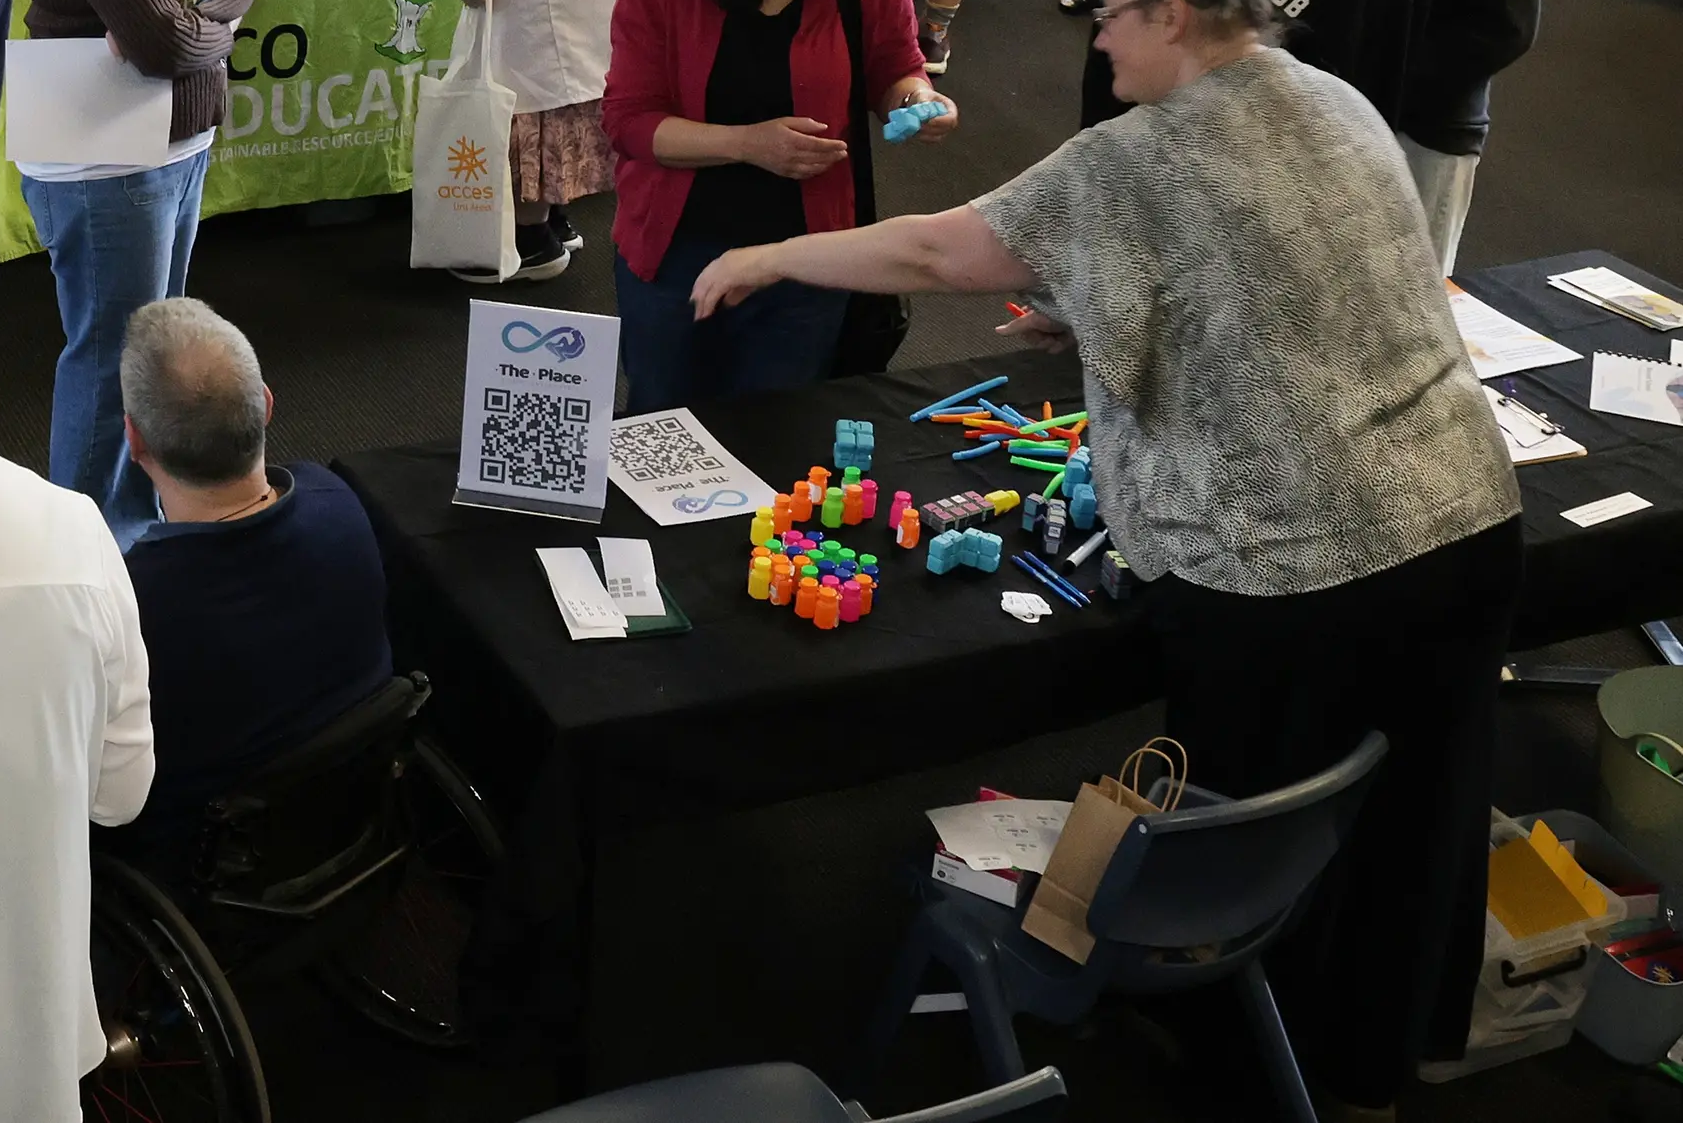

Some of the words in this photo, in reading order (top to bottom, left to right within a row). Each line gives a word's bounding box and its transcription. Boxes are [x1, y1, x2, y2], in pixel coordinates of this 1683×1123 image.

[227, 24, 308, 81] CO
[223, 59, 451, 140] DUCAT
[438, 186, 493, 199] acces
[499, 363, 529, 379] The
[538, 368, 582, 384] Place
[655, 481, 696, 492] Place
[699, 475, 729, 485] The
